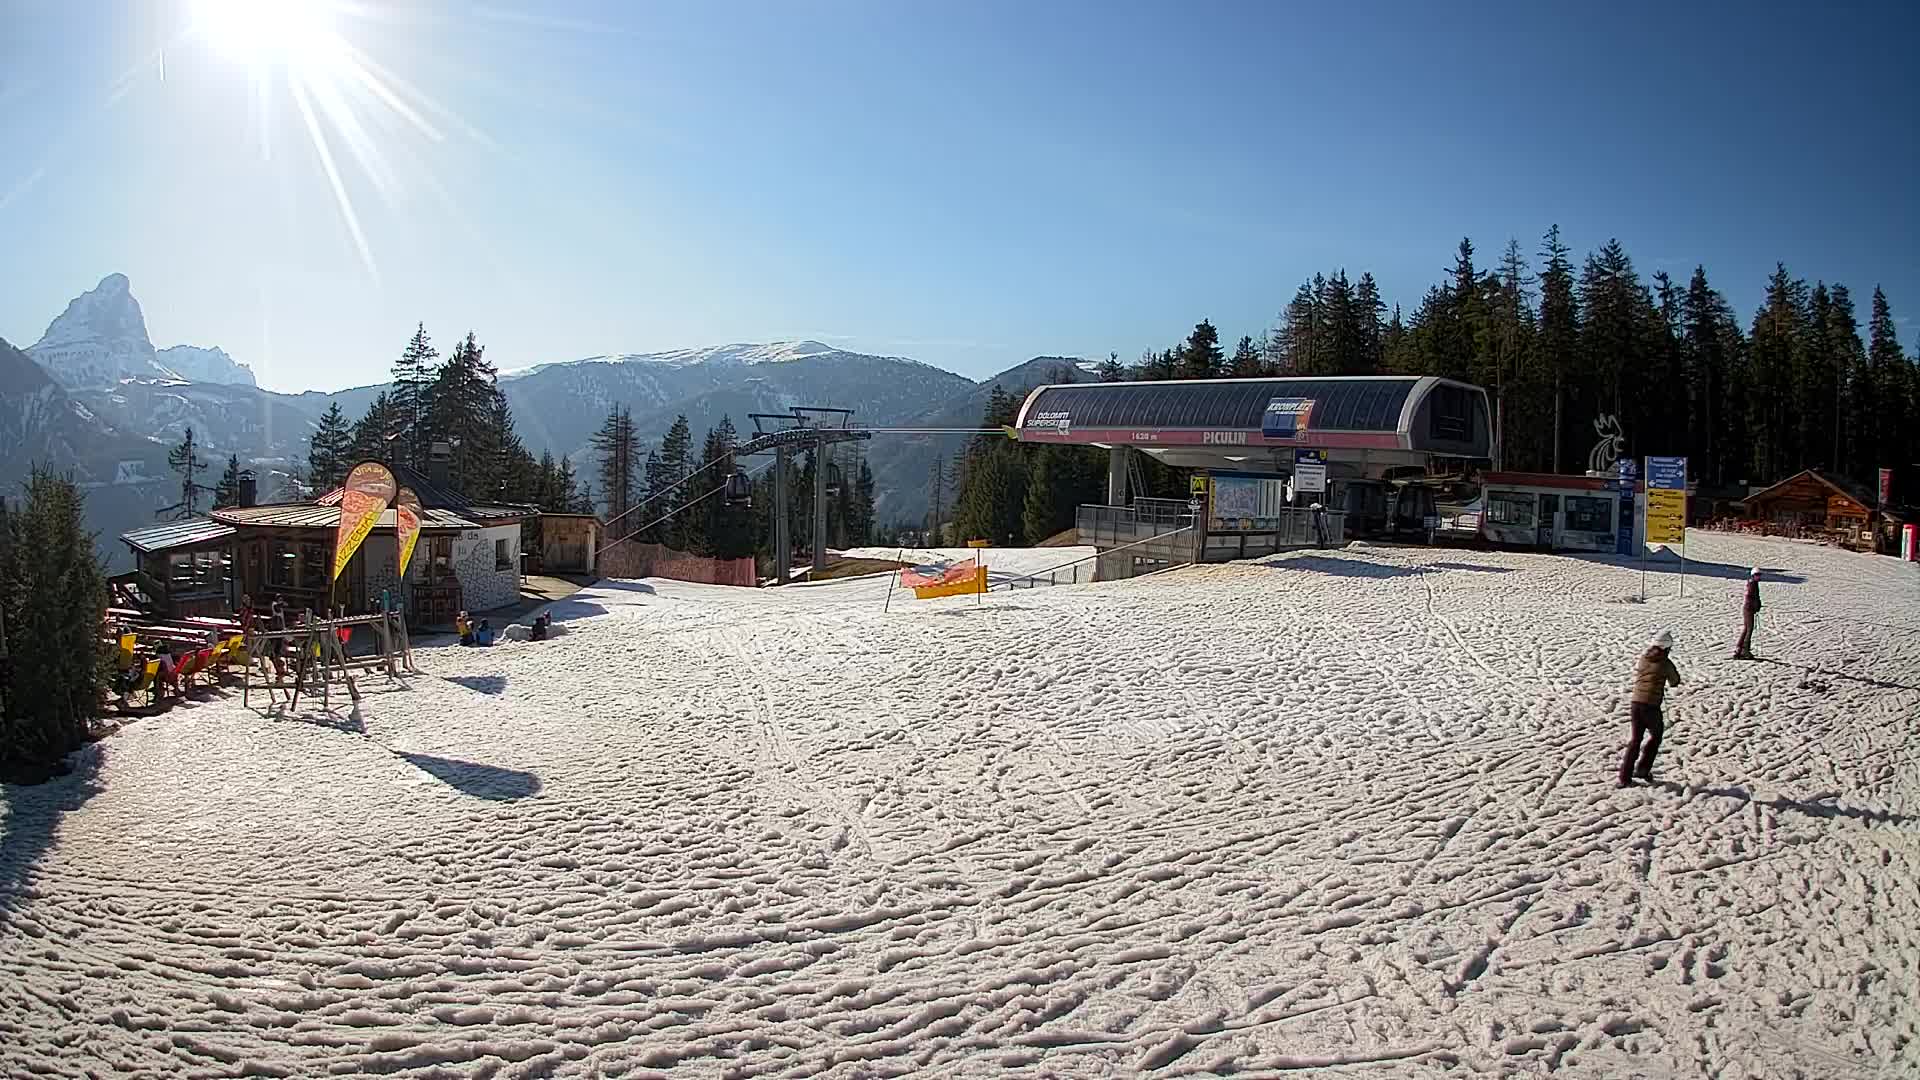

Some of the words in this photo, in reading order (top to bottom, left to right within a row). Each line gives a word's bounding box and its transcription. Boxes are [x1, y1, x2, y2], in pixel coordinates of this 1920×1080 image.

[1037, 411, 1070, 419] DOLOMITI
[1026, 419, 1059, 427] SUPERSKI
[1202, 431, 1247, 445] PICULIN
[335, 517, 374, 568] PIZZERIA
